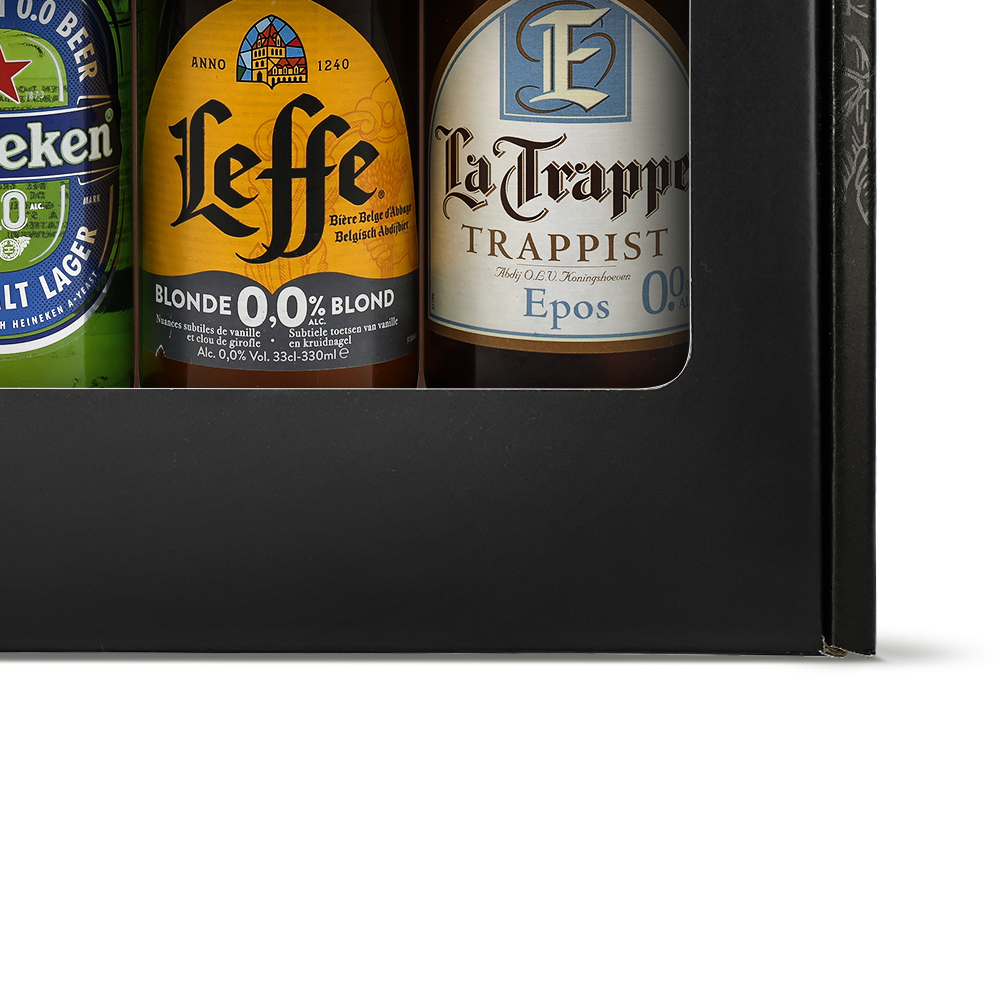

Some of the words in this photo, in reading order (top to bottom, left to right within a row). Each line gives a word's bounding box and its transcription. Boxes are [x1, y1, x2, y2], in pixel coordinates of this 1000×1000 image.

[55, 10, 99, 83] BEER
[519, 2, 614, 113] E
[191, 57, 226, 70] ANNO
[317, 58, 350, 72] 1240
[24, 91, 45, 100] 1873
[168, 93, 380, 265] Leffe
[435, 124, 497, 220] La
[493, 133, 690, 223] Trappe
[83, 194, 101, 205] MARK
[329, 213, 357, 226] Bière
[359, 210, 383, 224] Belge
[335, 227, 376, 243] Belgisch
[378, 220, 409, 236] Abdijbier
[461, 224, 669, 262] TRAPPIST
[39, 226, 98, 300] LAGER
[494, 266, 522, 282] Abdij
[558, 270, 631, 286] Koningshoeven
[12, 306, 64, 329] HEINEKEN
[68, 270, 98, 308] A-YEAST
[155, 283, 232, 316] BLONDE
[331, 289, 395, 315] BLOND
[523, 287, 610, 330] Epos
[156, 313, 182, 329] Nuances
[183, 322, 215, 335] subtiles
[217, 326, 228, 336] de
[230, 328, 261, 338] vanille
[289, 327, 328, 338] Subtiele
[330, 325, 361, 335] toetsen
[364, 323, 377, 332] van
[378, 316, 399, 329] vanille
[186, 334, 195, 342] et
[196, 334, 214, 345] clou
[216, 336, 227, 346] de
[229, 338, 261, 349] girofle
[289, 339, 300, 348] en
[303, 335, 352, 348] kruidnagel
[197, 346, 216, 358] Alc.
[219, 348, 247, 362] 0,0%
[249, 351, 270, 362] Vol.
[273, 348, 337, 362] 33cl-330ml
